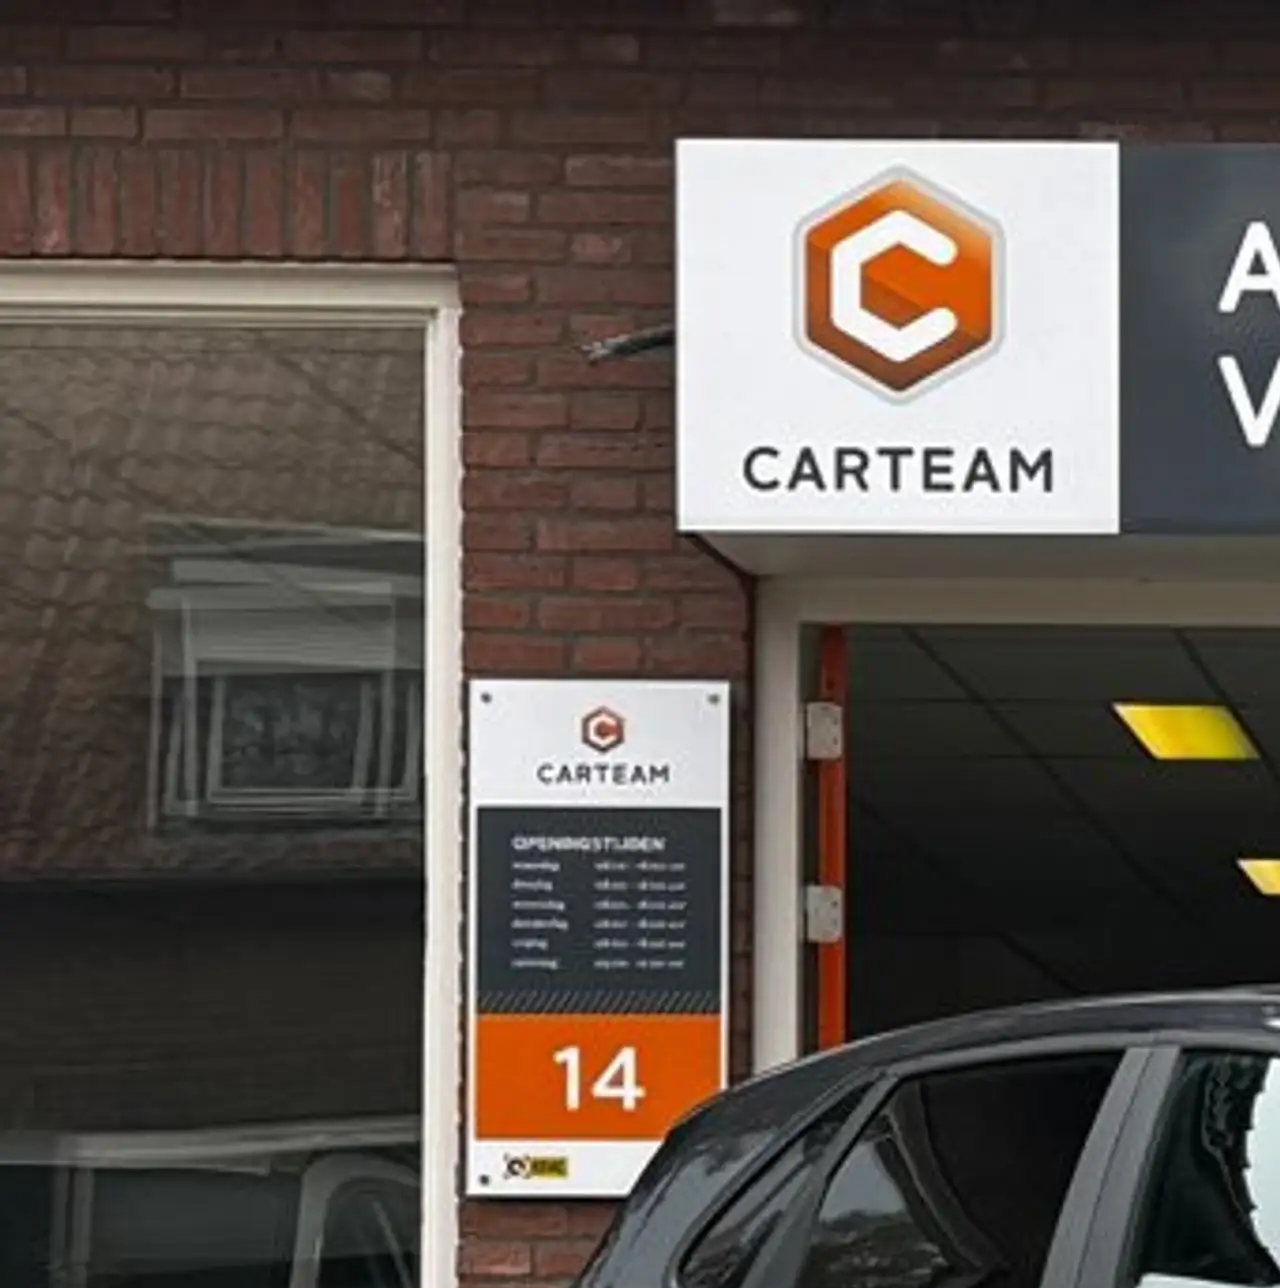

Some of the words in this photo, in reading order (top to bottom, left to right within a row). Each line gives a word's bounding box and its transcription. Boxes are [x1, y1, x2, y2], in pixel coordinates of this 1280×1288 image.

[742, 446, 1055, 493] CARTEAM
[536, 763, 671, 785] CARTEAM
[552, 1045, 646, 1113] 14
